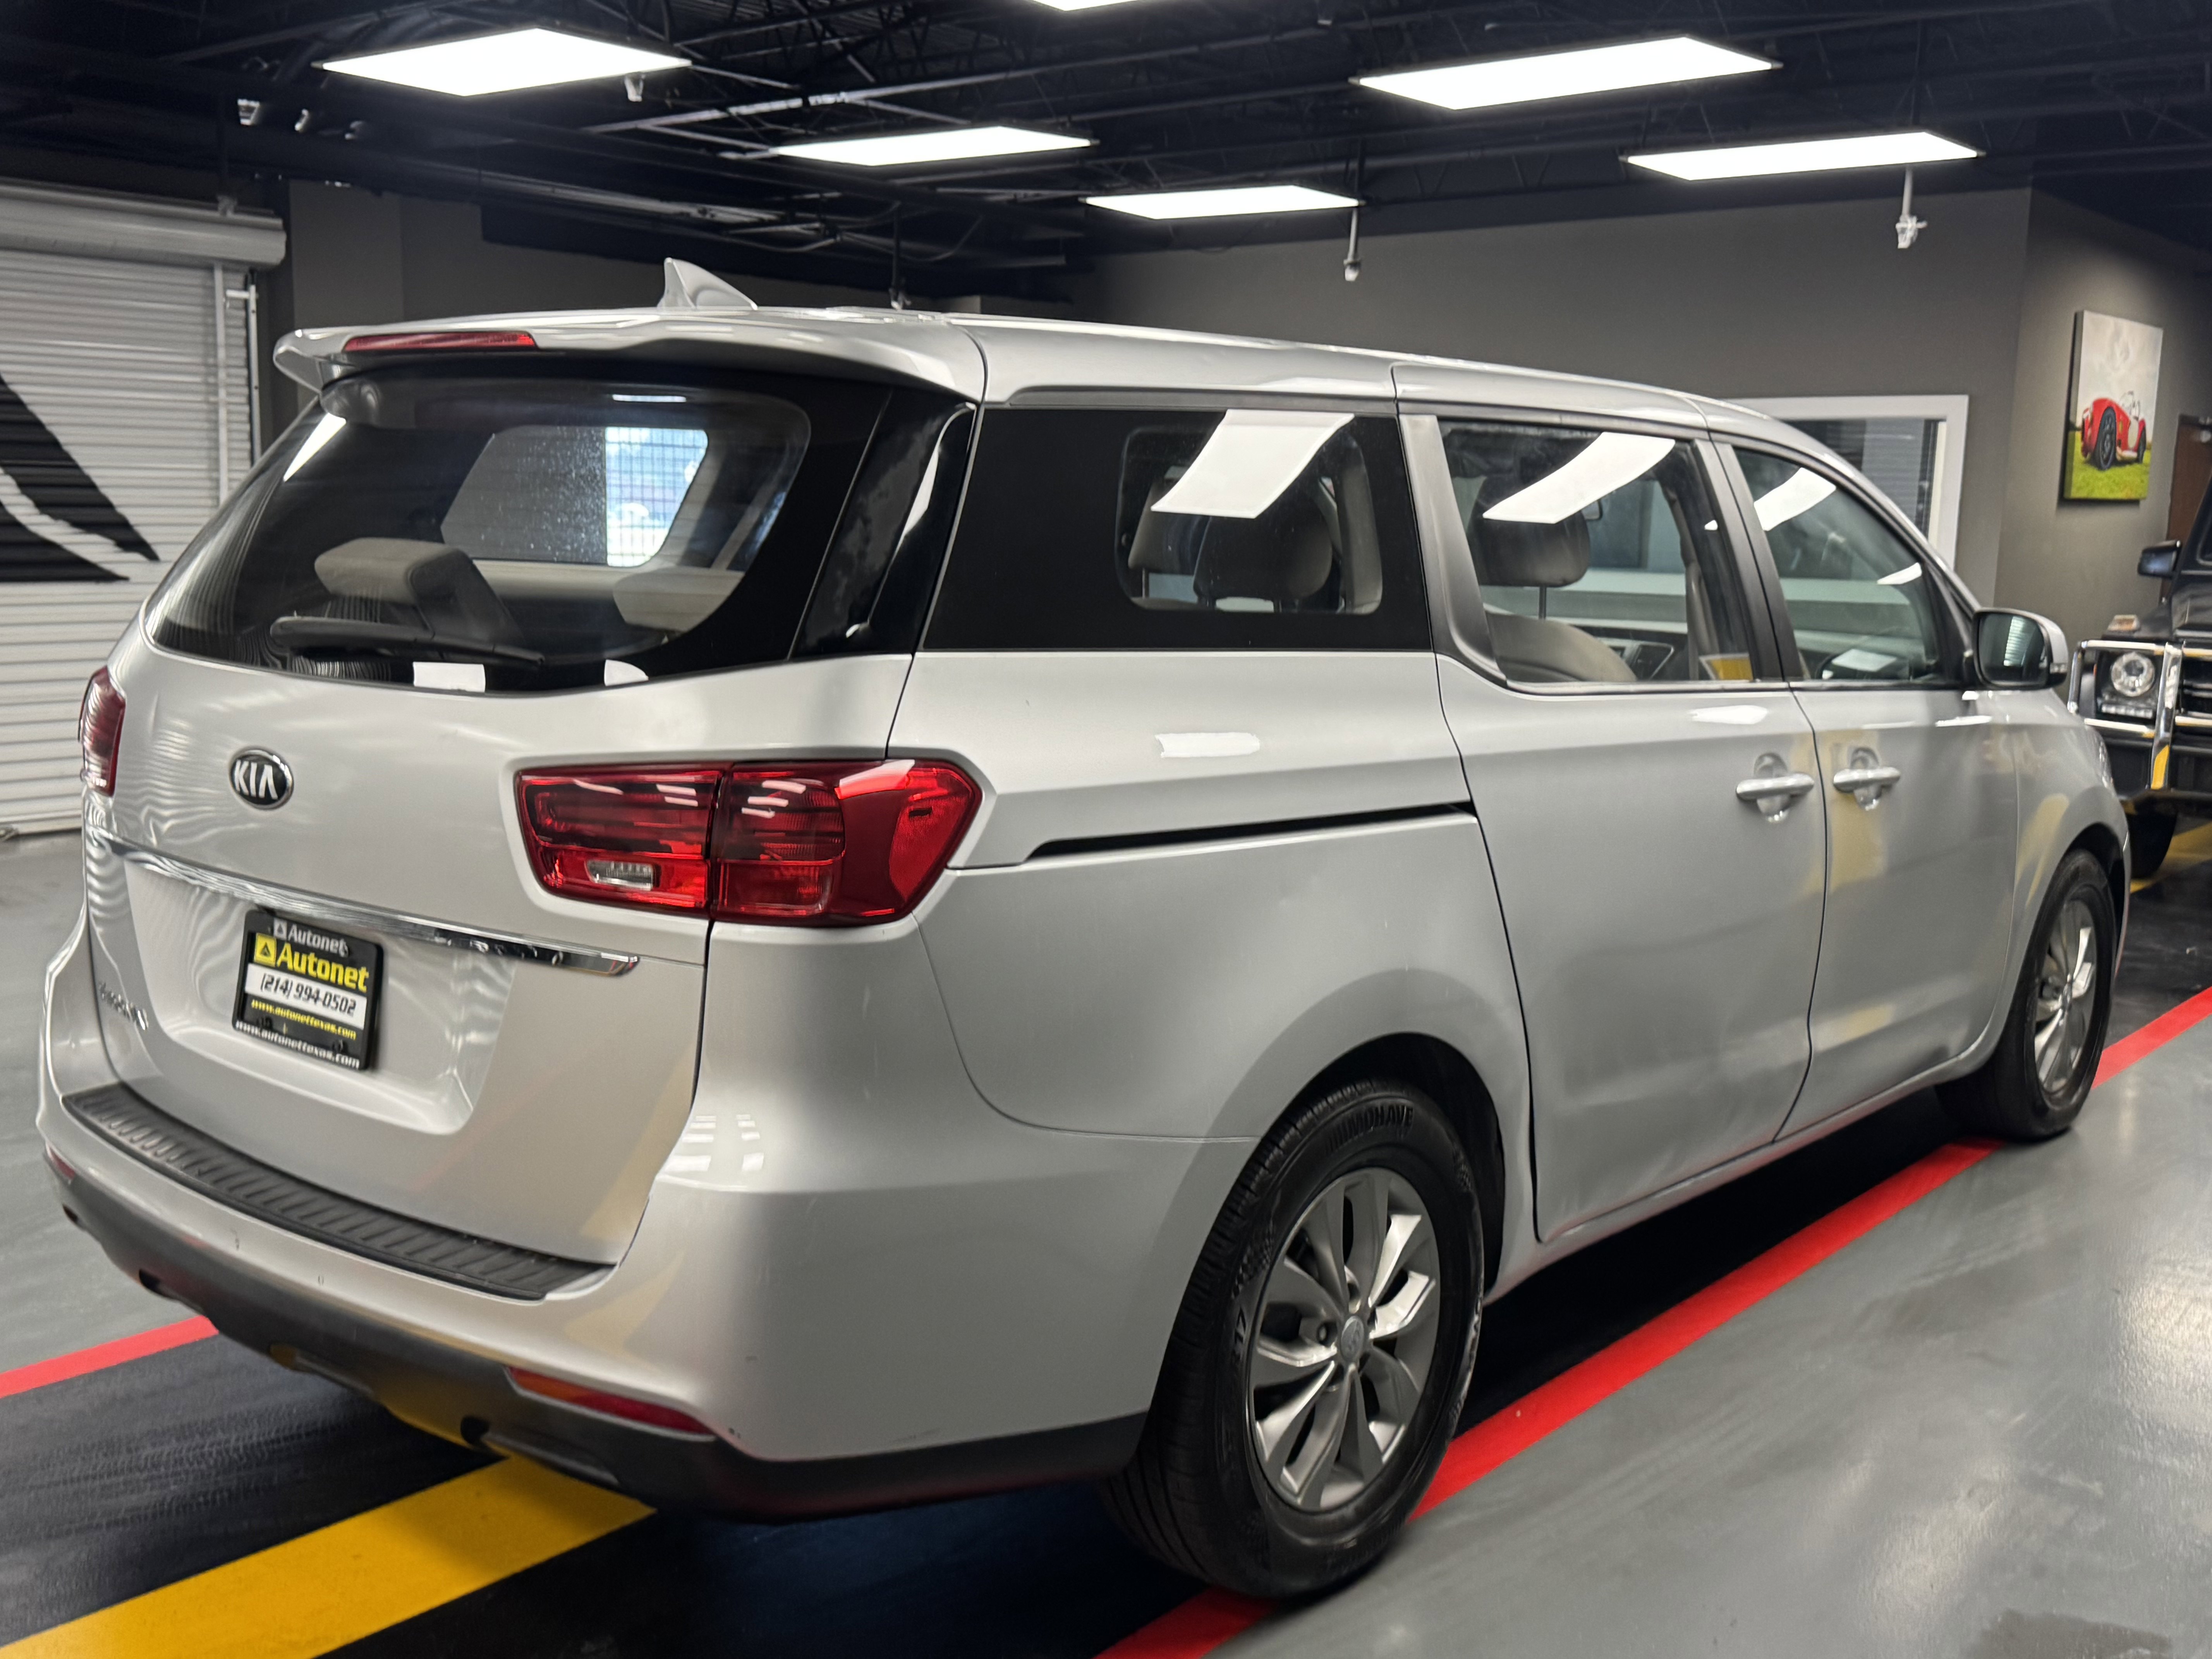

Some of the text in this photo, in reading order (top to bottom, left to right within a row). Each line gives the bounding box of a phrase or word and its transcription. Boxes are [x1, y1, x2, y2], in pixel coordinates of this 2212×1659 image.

[234, 759, 278, 800] KIA
[288, 924, 349, 958] Autonet
[276, 942, 369, 993] Autonet
[260, 972, 356, 1017] (214) 994-0502
[251, 999, 357, 1041] www.autonettexas.com
